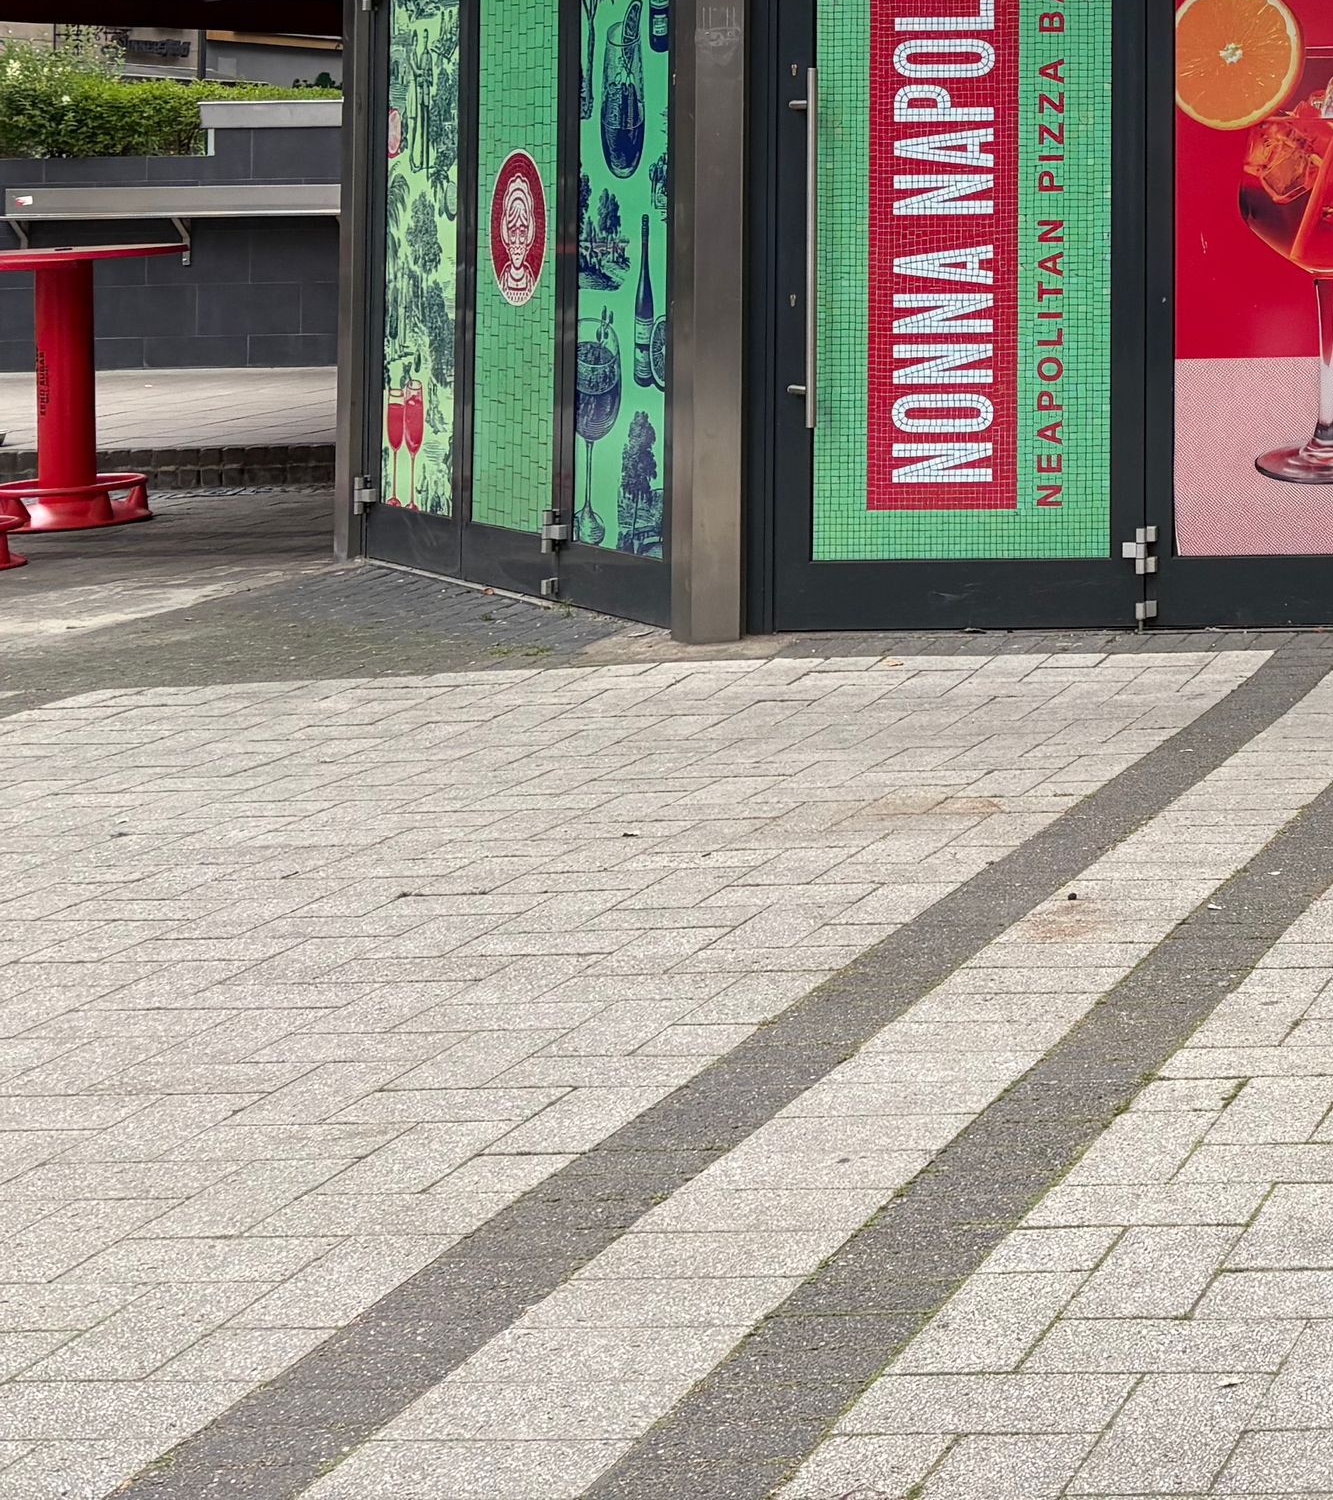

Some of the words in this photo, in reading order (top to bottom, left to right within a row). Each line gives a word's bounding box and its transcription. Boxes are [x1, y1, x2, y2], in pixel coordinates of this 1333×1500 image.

[1039, 59, 1066, 193] PIZZA
[892, 243, 995, 484] NONNA
[1036, 219, 1065, 507] NEAPOLITAN
